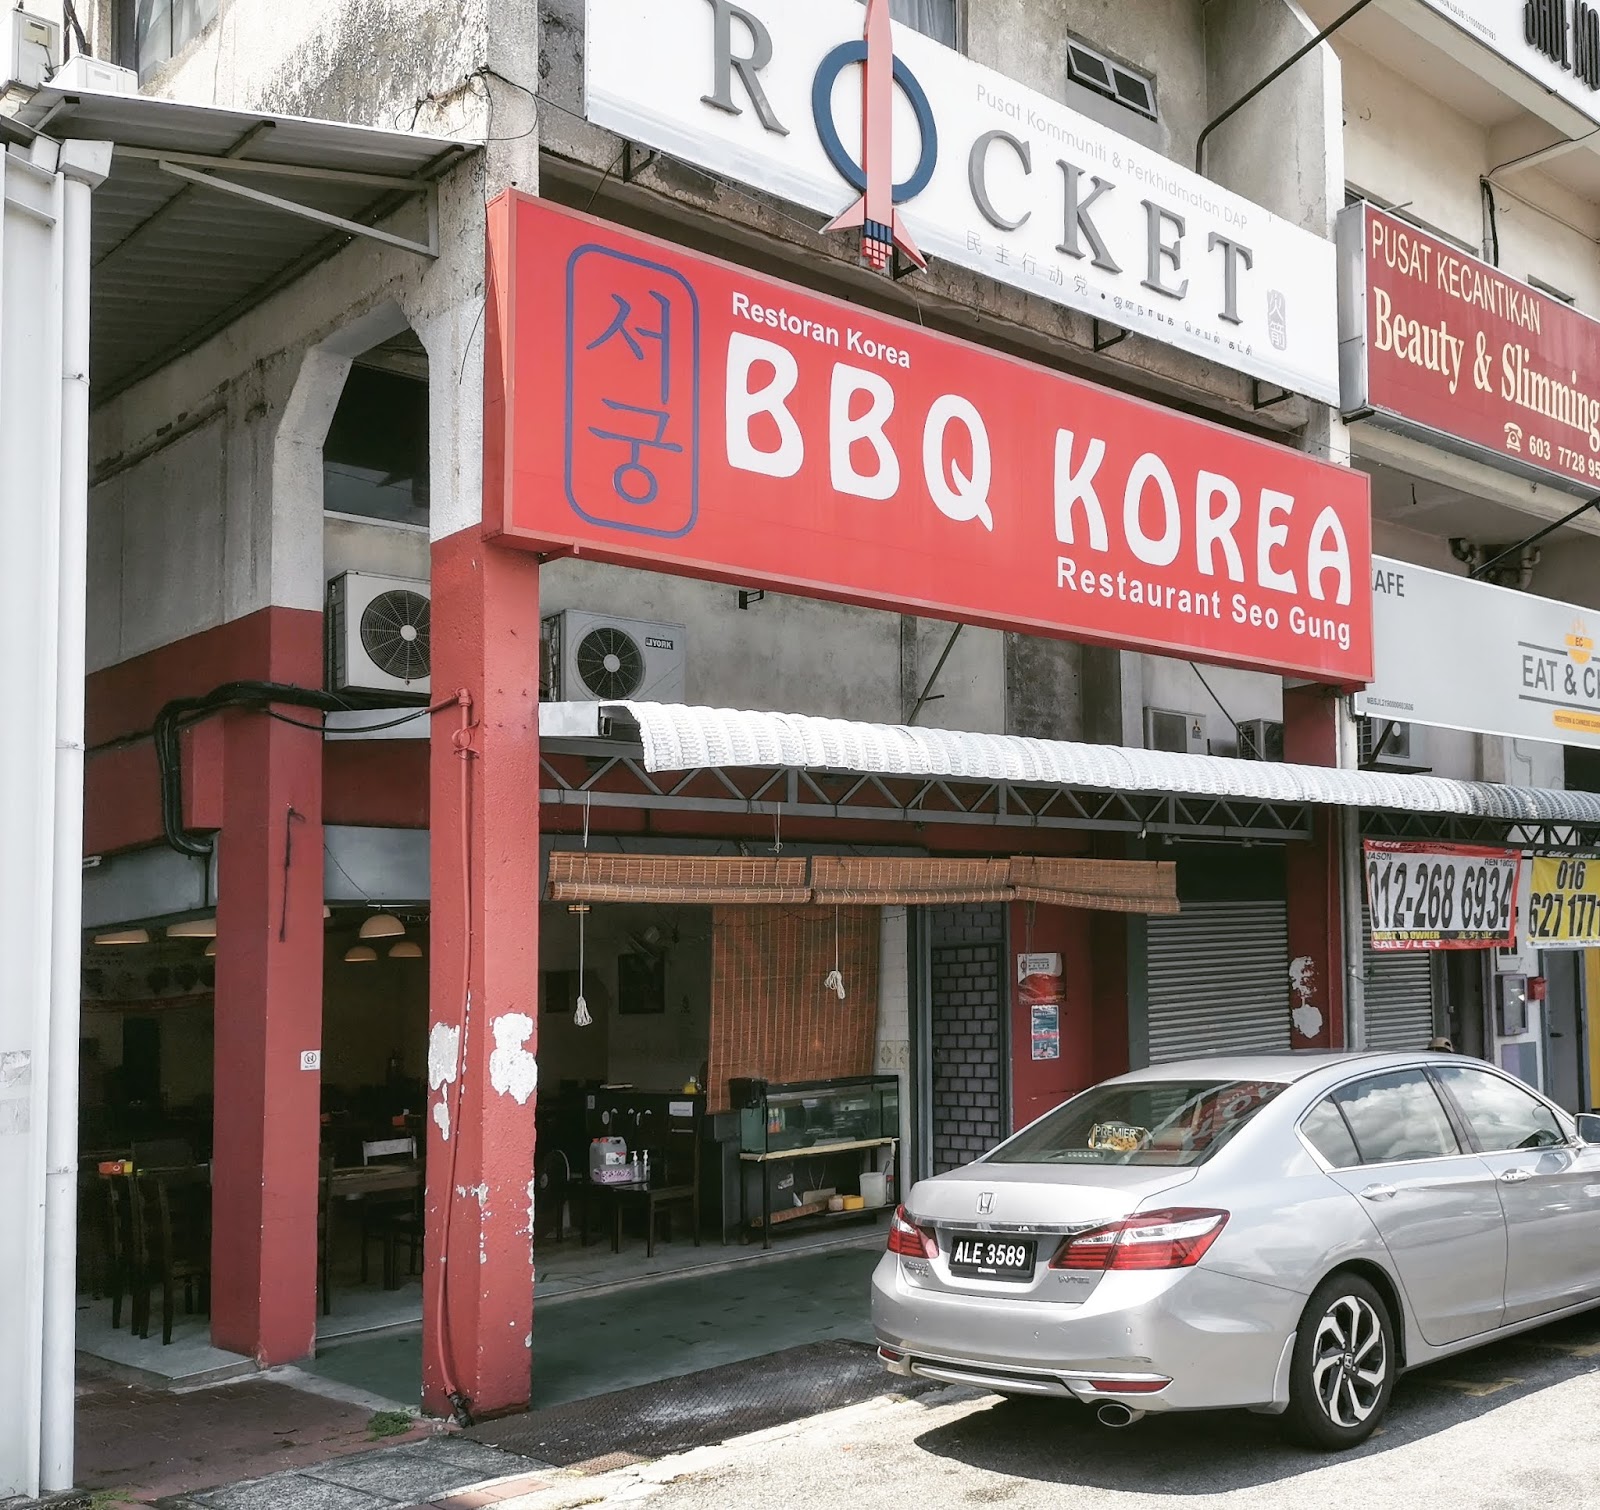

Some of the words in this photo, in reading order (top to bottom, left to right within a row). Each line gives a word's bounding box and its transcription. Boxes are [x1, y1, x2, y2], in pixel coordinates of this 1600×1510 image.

[700, 0, 1254, 325] ROCKET
[977, 84, 1021, 121] Pusat
[1028, 108, 1107, 163] Kommuniti
[1112, 151, 1123, 170] &
[1127, 158, 1221, 218] Perkhidmatan
[1225, 206, 1249, 231] DAP
[966, 230, 1088, 297] 民主行动党
[1371, 219, 1431, 284] PUSAT
[1436, 255, 1541, 336] KECANTIKAN
[731, 291, 839, 346] Restoran
[846, 325, 911, 371] Korea
[1373, 286, 1465, 395] Beauty
[1473, 330, 1493, 394] &
[1501, 342, 1600, 453] Slimming
[585, 286, 683, 506] 서궁
[725, 330, 994, 532] BBQ
[1053, 427, 1353, 606] KOREA
[1529, 435, 1551, 461] 603
[1558, 446, 1585, 473] 7728
[1056, 556, 1222, 620] Restaurant
[1231, 596, 1280, 632] Seo
[1289, 606, 1352, 652] Gung
[1372, 569, 1405, 598] AFE
[651, 639, 672, 649] YORK
[1522, 654, 1558, 692] EAT
[1564, 663, 1577, 696] &
[1583, 667, 1600, 700] C
[1366, 852, 1392, 861] JASON
[1556, 859, 1586, 890] 016
[1369, 861, 1456, 929] 012-268
[1461, 866, 1514, 929] 6934
[1529, 892, 1564, 939] 627
[1373, 940, 1442, 949] SALE/LET
[1410, 931, 1440, 940] OWNER
[1095, 1125, 1136, 1139] PREMIER
[953, 1240, 983, 1264] ALE
[986, 1241, 1027, 1267] 3589
